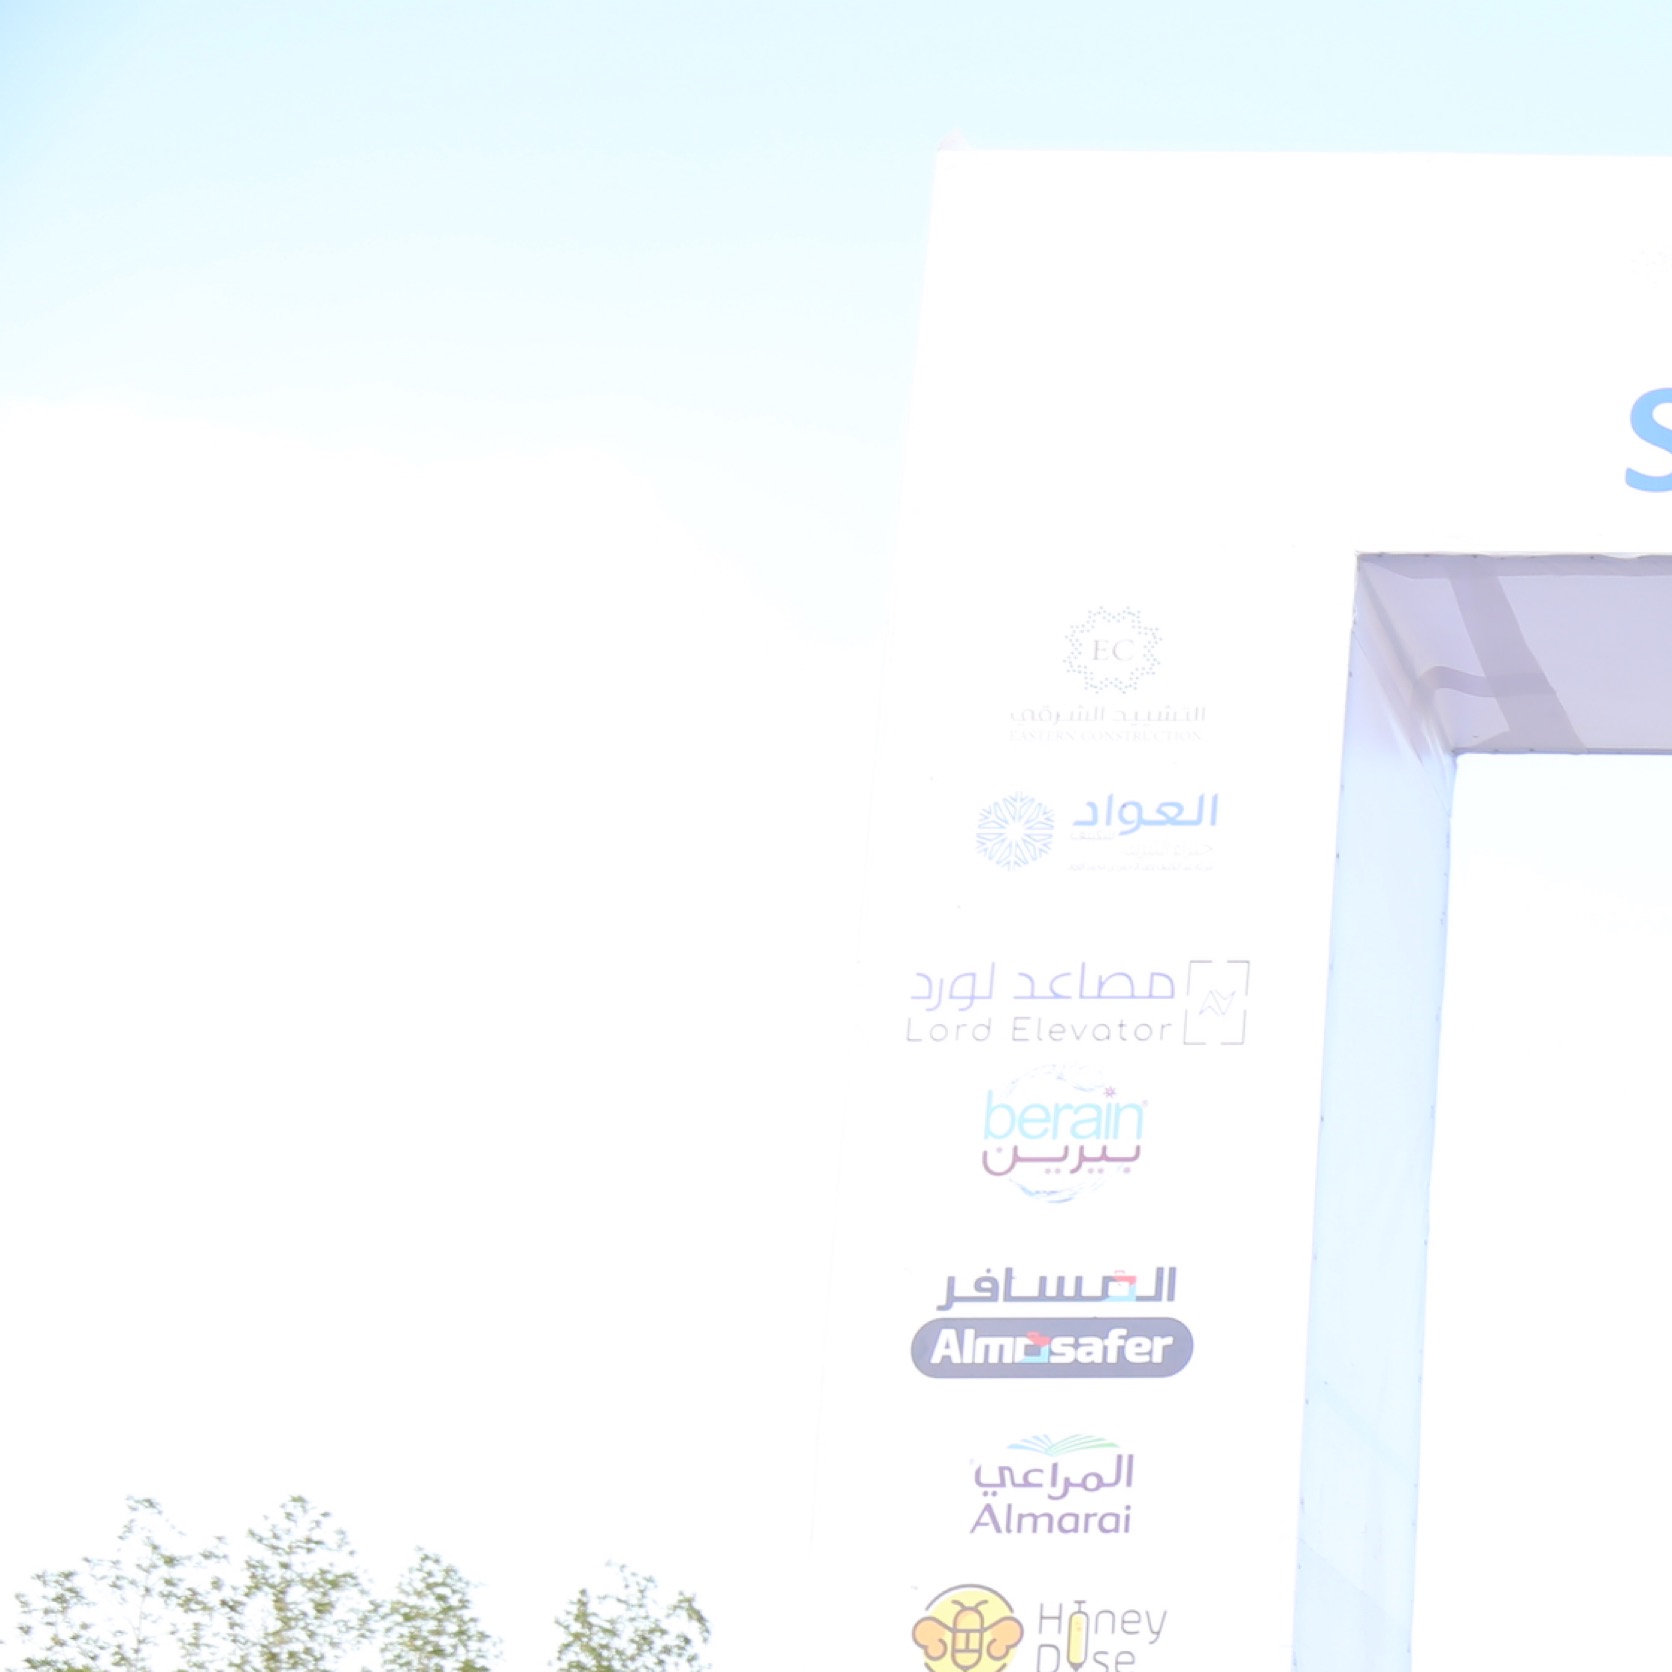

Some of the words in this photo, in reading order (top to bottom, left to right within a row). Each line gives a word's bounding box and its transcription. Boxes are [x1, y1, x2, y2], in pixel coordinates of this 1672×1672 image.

[1072, 793, 1219, 836] العواد
[910, 961, 996, 1012] لورد
[1012, 961, 1176, 1000] مصاعد
[905, 1017, 992, 1043] Lord
[1011, 1016, 1173, 1042] Elevator
[983, 1086, 1147, 1141] berain
[981, 1144, 1141, 1177] بيرين
[935, 1266, 1177, 1312] المسافر
[930, 1328, 1174, 1364] Almosafer
[973, 1453, 1135, 1501] المراعي
[969, 1502, 1132, 1534] Almarai
